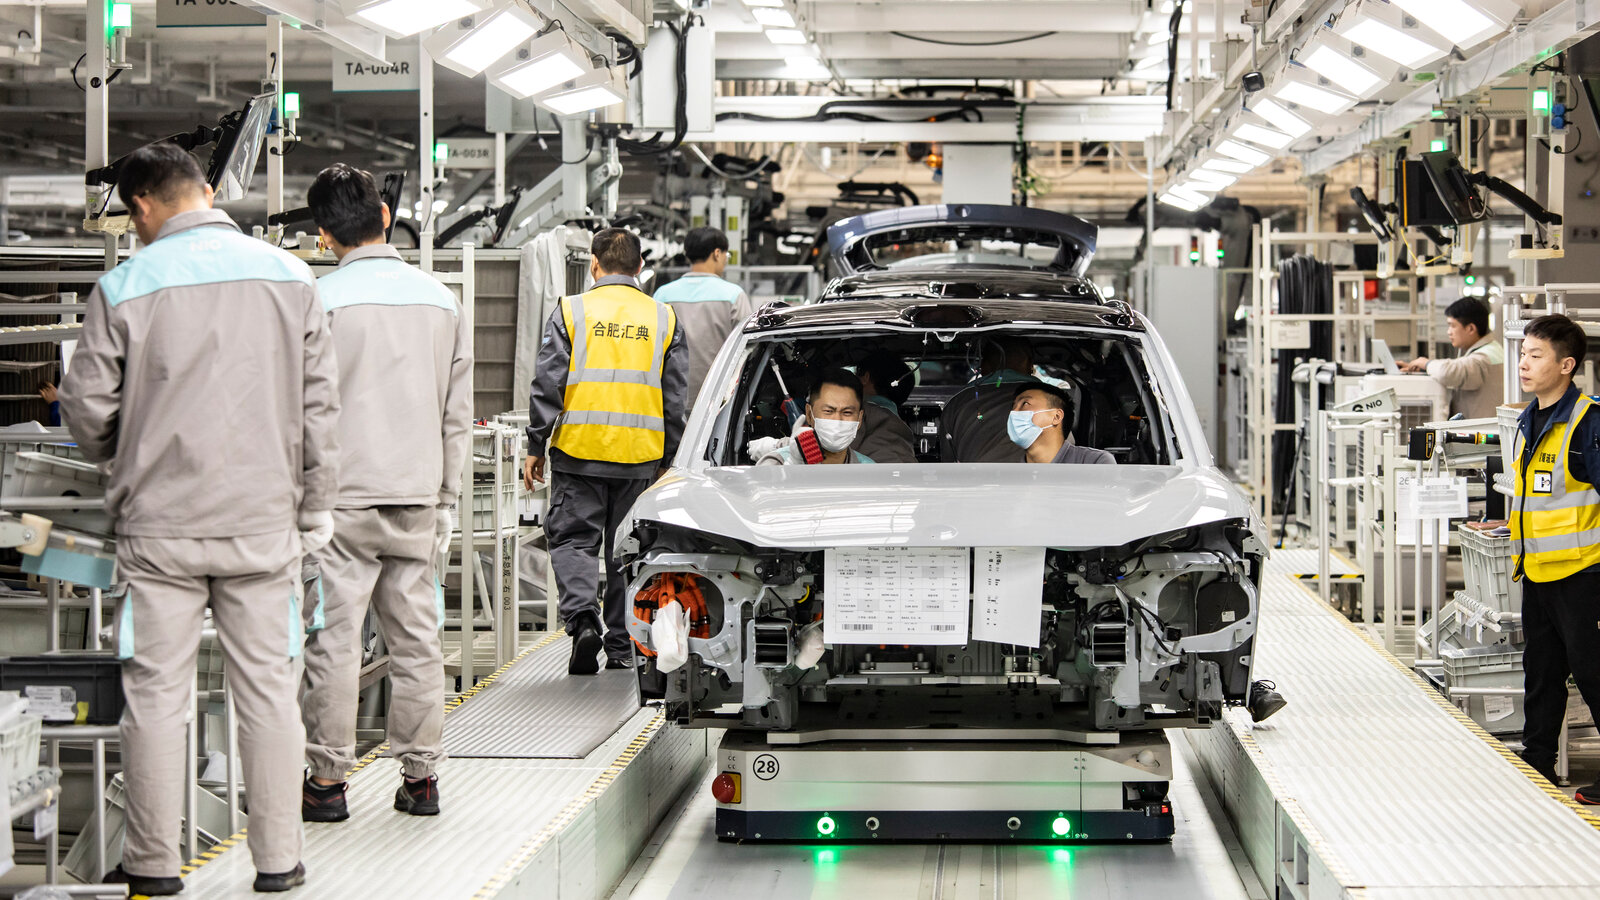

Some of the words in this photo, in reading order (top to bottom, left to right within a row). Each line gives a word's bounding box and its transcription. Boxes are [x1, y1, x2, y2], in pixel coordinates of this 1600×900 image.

[345, 61, 409, 75] TA-004R
[592, 320, 650, 342] 合肥汇典
[1365, 399, 1383, 410] NIO
[756, 759, 776, 774] 28
